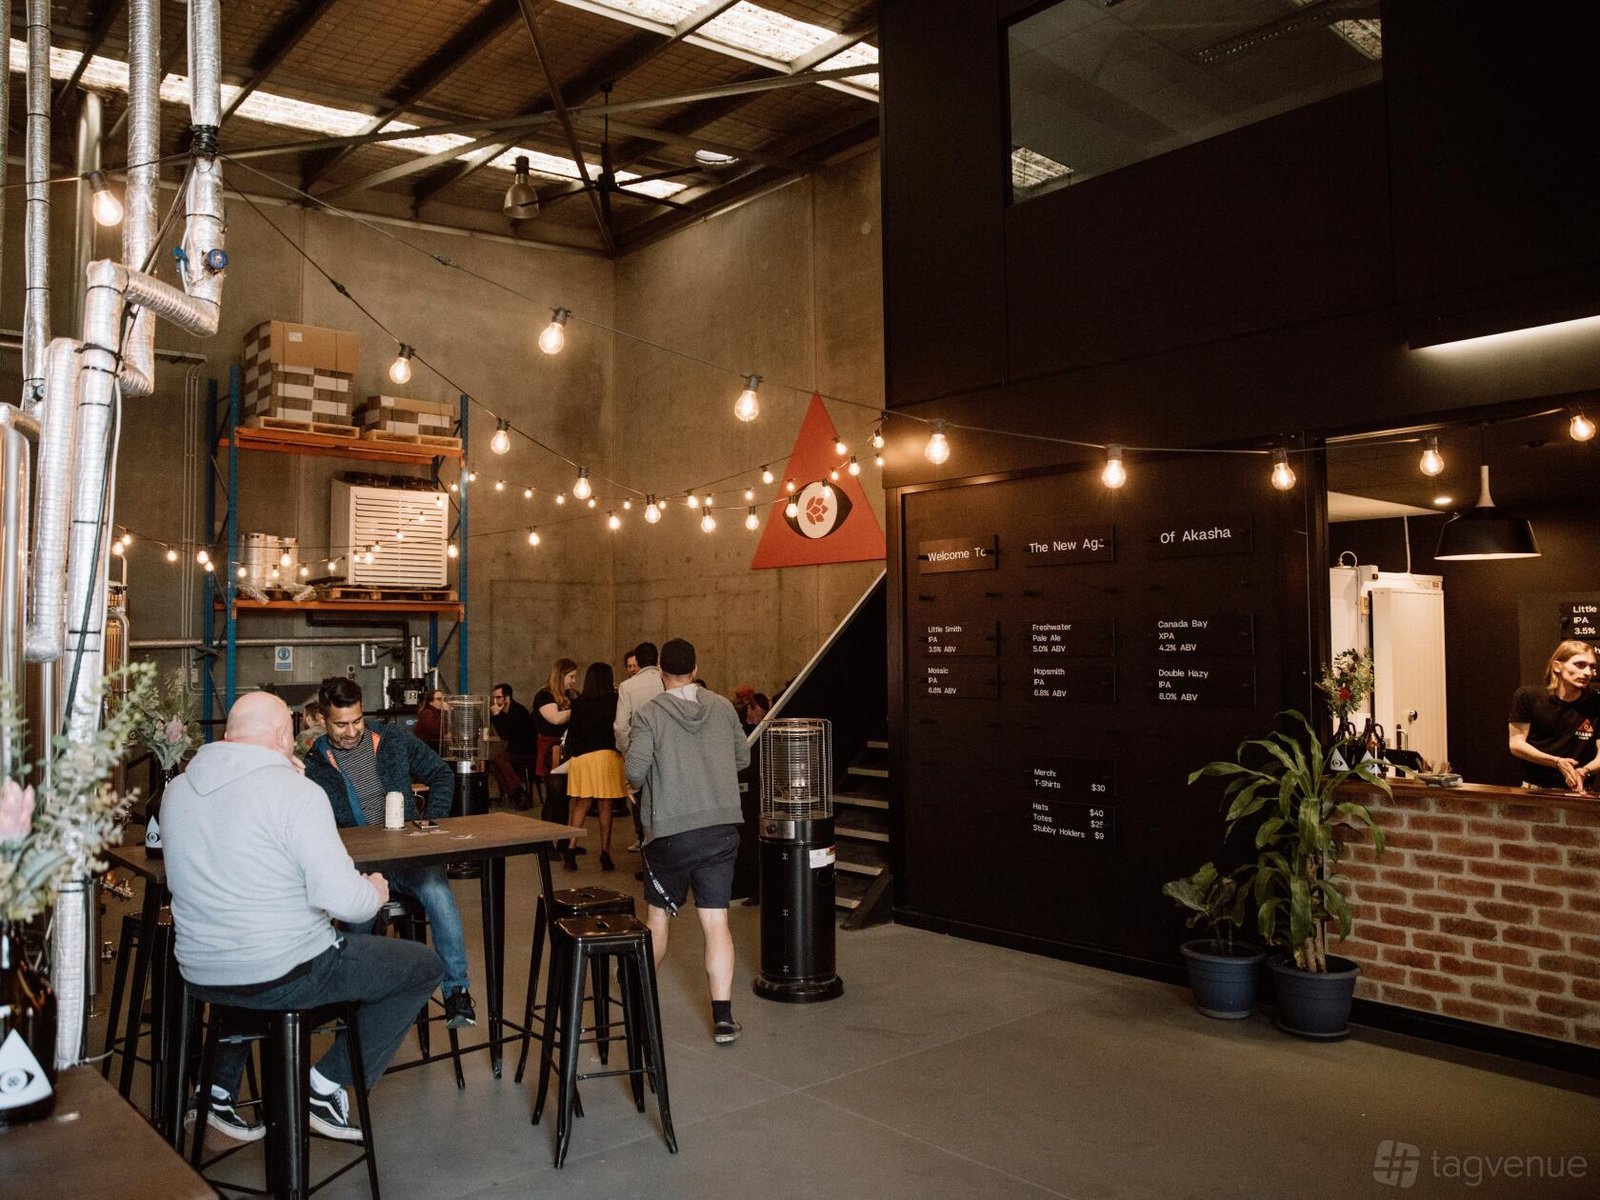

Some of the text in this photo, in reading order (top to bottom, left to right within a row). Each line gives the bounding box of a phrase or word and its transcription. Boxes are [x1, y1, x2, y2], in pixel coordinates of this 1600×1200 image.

[1160, 526, 1231, 544] Of Akasha
[1028, 541, 1049, 554] The
[1053, 539, 1077, 552] New
[928, 550, 970, 562] Welcome
[1573, 605, 1597, 614] Little
[1158, 619, 1208, 630] Canada Bay
[1573, 617, 1589, 625] IPA
[928, 625, 962, 633] Little Smith
[1032, 623, 1071, 632] Freshwater
[1574, 627, 1596, 635] 3.5%
[1033, 634, 1061, 642] Pale Ale
[1158, 632, 1175, 640] XPA
[1033, 645, 1066, 653] 5.0% ABV
[1159, 643, 1197, 652] 4.2% ABV
[928, 667, 949, 675] Mosaic
[1033, 667, 1065, 677] Hopsmith
[1158, 668, 1209, 680] Double Hazy
[1033, 678, 1045, 686] IPA
[1158, 680, 1171, 689] IPA
[1052, 689, 1067, 697] ABV
[1158, 692, 1198, 701] 8.0% ABV
[1034, 779, 1106, 792] T-Shirts $30
[1032, 802, 1104, 817] Hats $40
[1033, 813, 1053, 822] Totes
[1032, 823, 1105, 841] Stubby Holders $9
